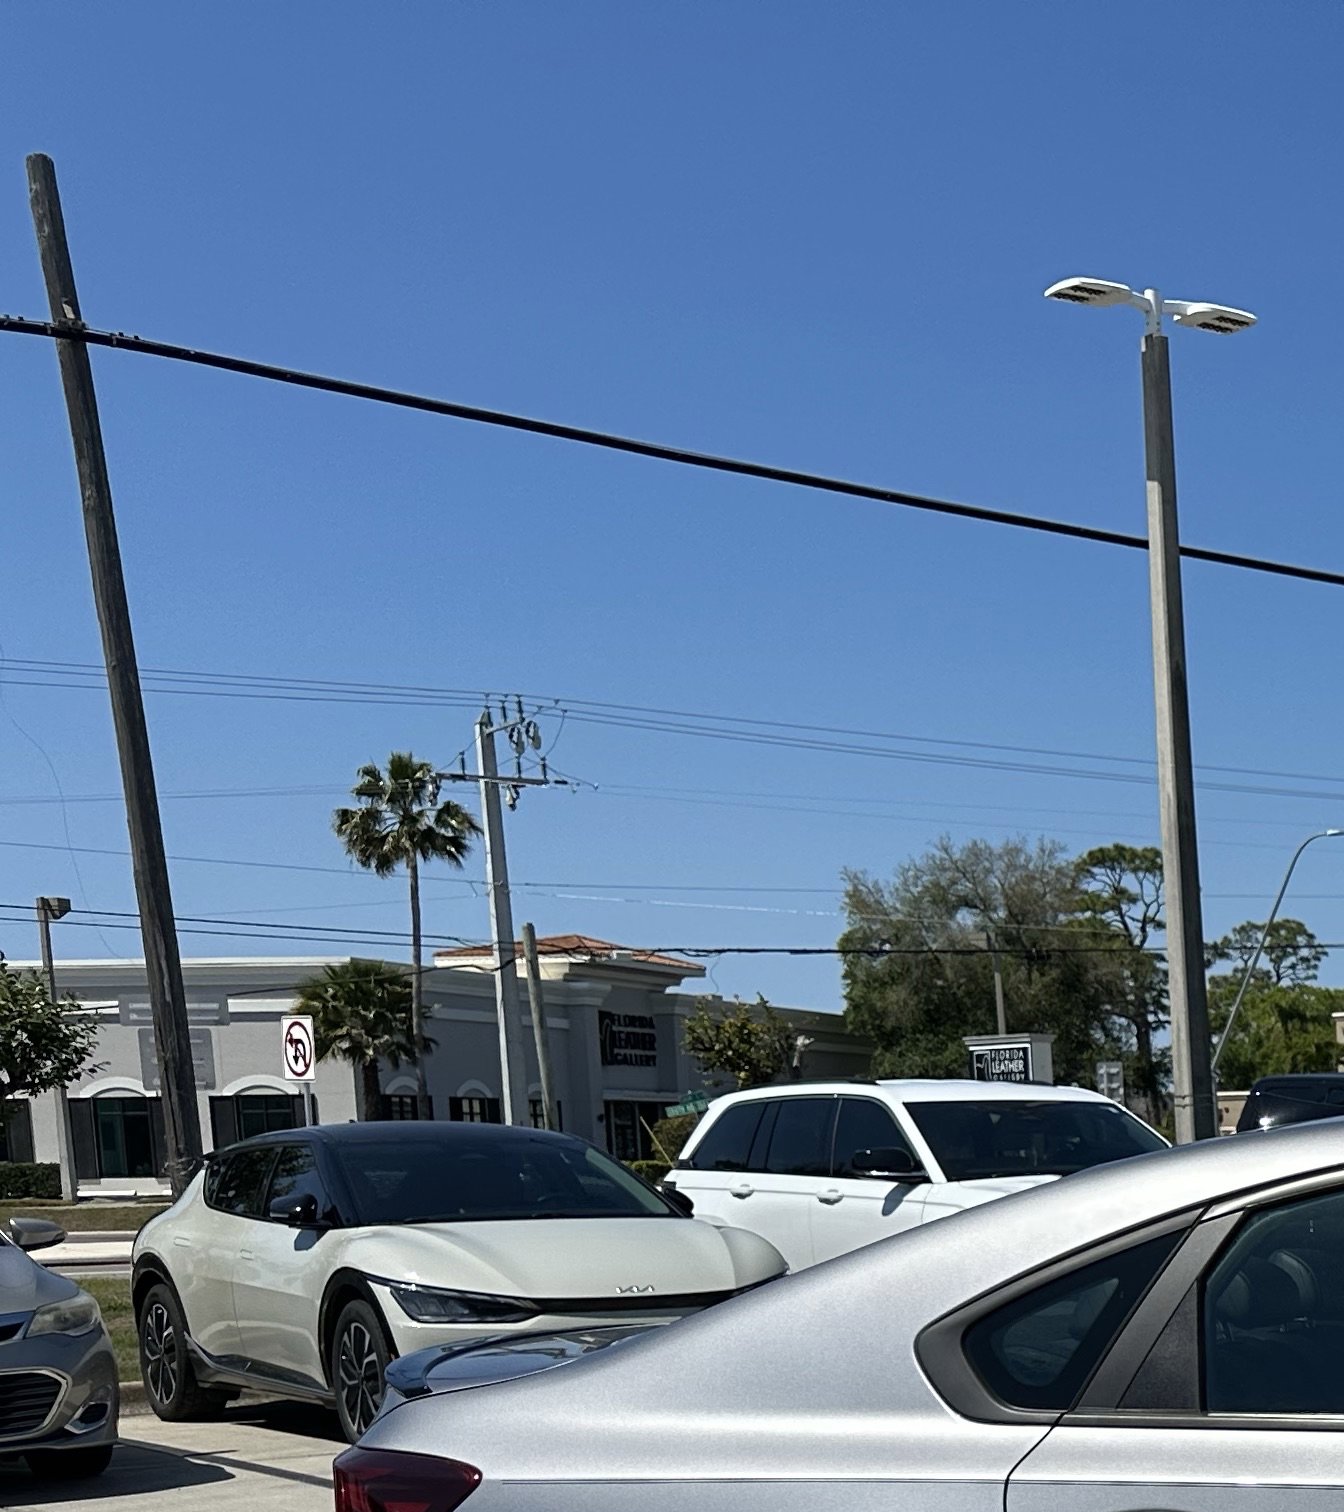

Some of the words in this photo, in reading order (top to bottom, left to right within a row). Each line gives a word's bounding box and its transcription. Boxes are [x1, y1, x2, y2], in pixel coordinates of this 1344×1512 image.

[611, 1013, 655, 1029] FLORIDA
[611, 1030, 657, 1051] LEATHER
[614, 1053, 657, 1066] GALLERY
[991, 1049, 1025, 1061] FLORIDA
[991, 1060, 1026, 1074] LEATHER
